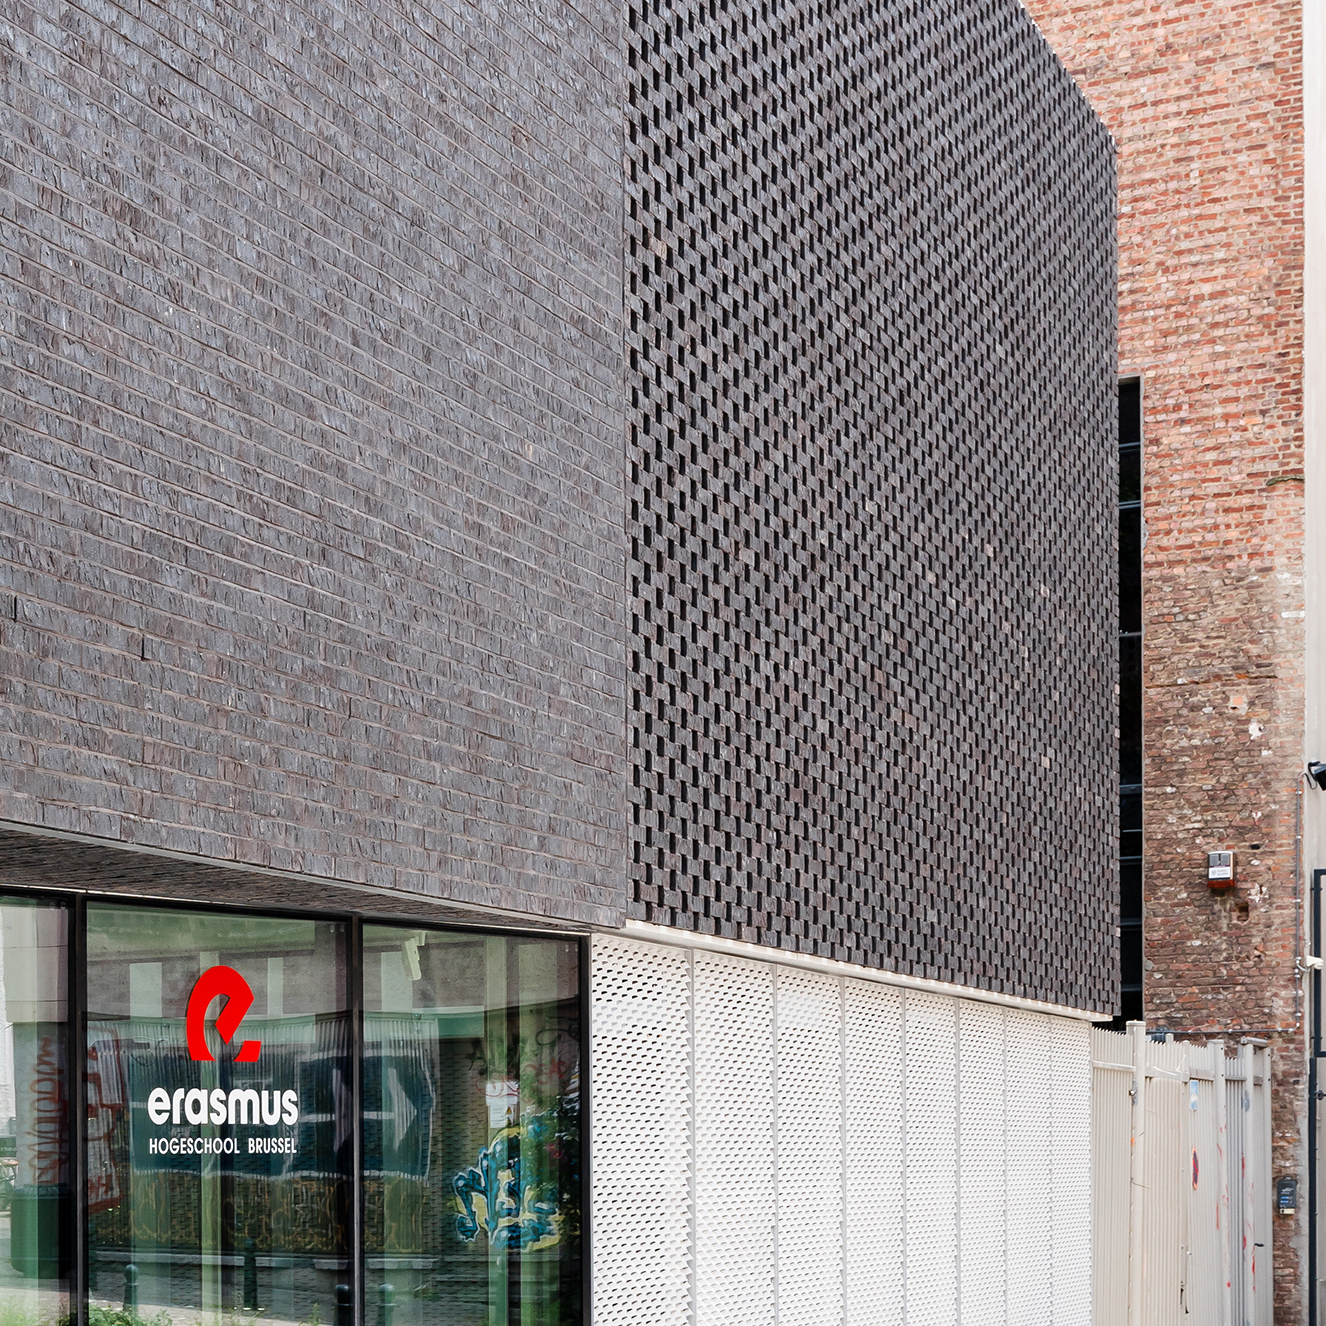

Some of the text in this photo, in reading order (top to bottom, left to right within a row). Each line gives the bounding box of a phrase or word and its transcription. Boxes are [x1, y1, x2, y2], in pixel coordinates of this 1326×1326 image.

[147, 1087, 299, 1125] erasmus
[149, 1137, 297, 1155] HOGESCHOOL BRUSSEL
